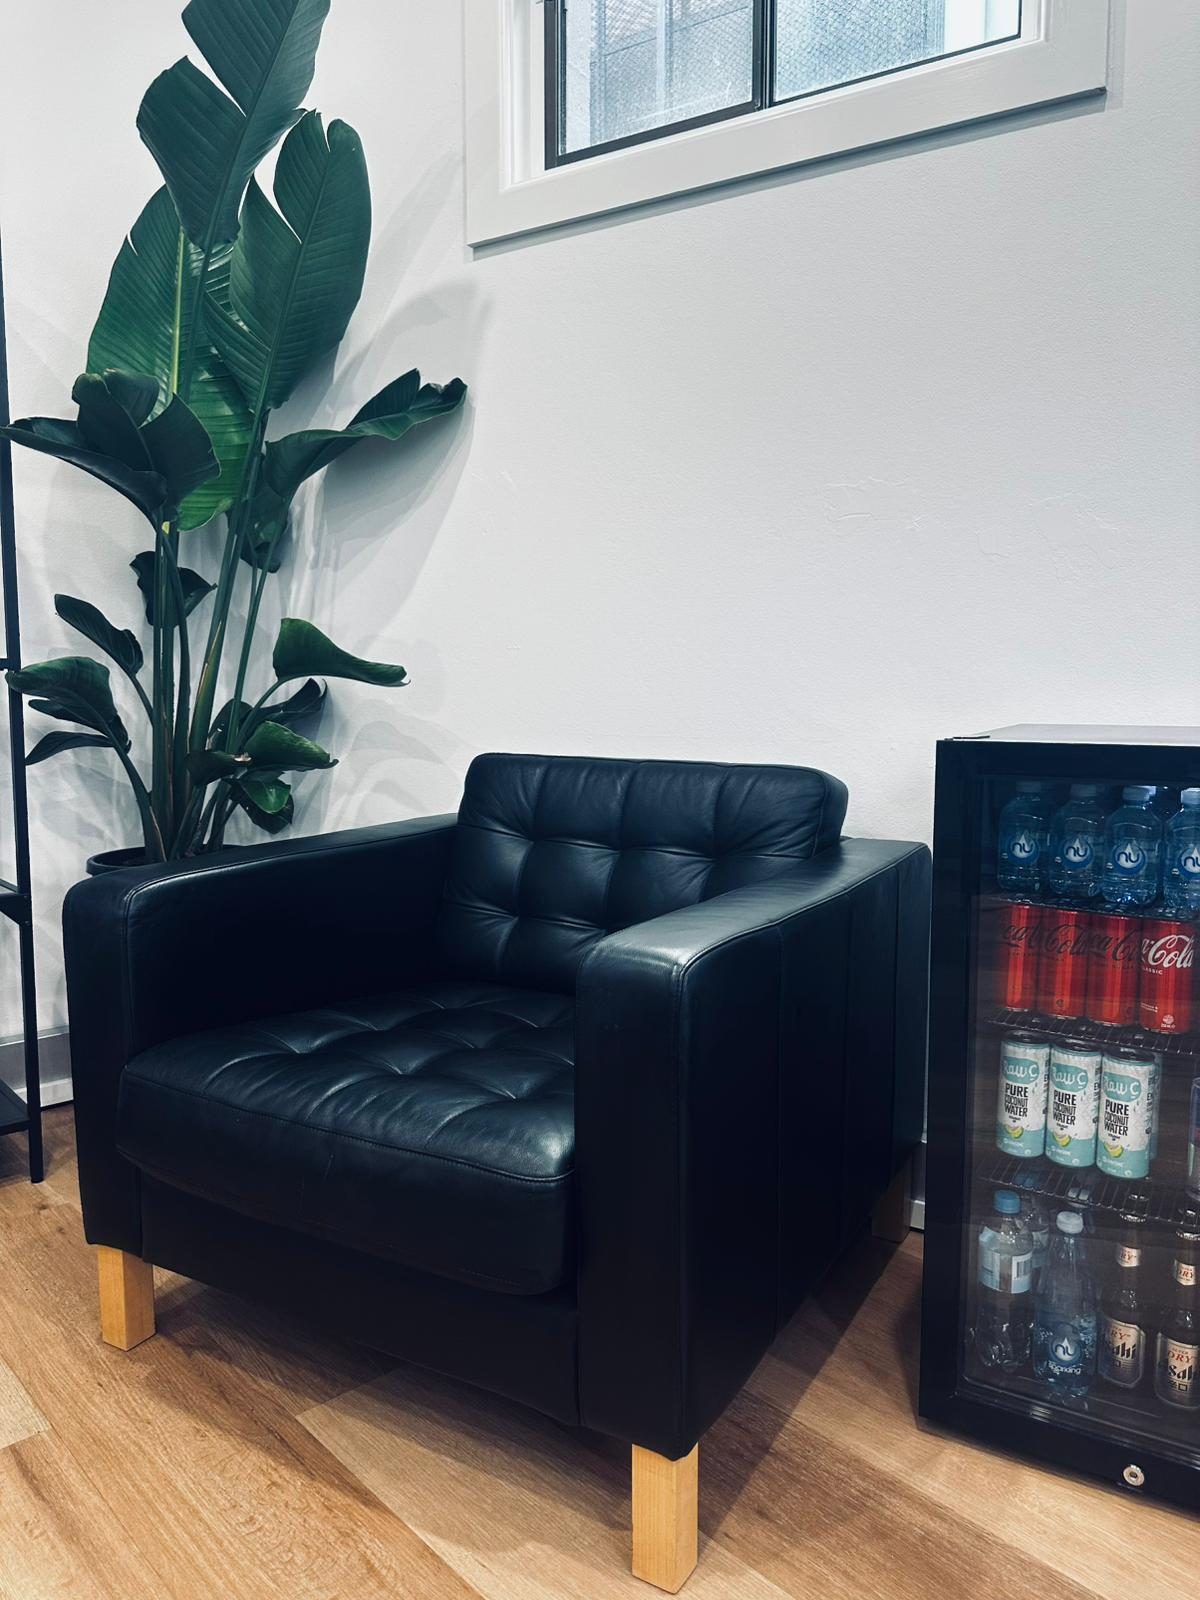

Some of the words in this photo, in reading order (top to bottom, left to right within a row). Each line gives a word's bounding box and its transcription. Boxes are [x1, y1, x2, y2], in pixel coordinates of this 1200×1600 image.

[1012, 842, 1033, 854] nu
[1065, 845, 1088, 858] nu
[1117, 850, 1140, 864] nu
[1005, 1082, 1029, 1098] PURE
[1053, 1089, 1077, 1106] PURE
[1004, 1094, 1028, 1108] COCONUT
[1053, 1101, 1077, 1116] COCONUT
[1105, 1099, 1130, 1116] PURE
[1004, 1103, 1028, 1118] WATER
[1053, 1110, 1076, 1126] WATER
[1104, 1110, 1129, 1126] COCONUT
[1104, 1121, 1129, 1137] WATER
[1055, 1343, 1077, 1357] nu
